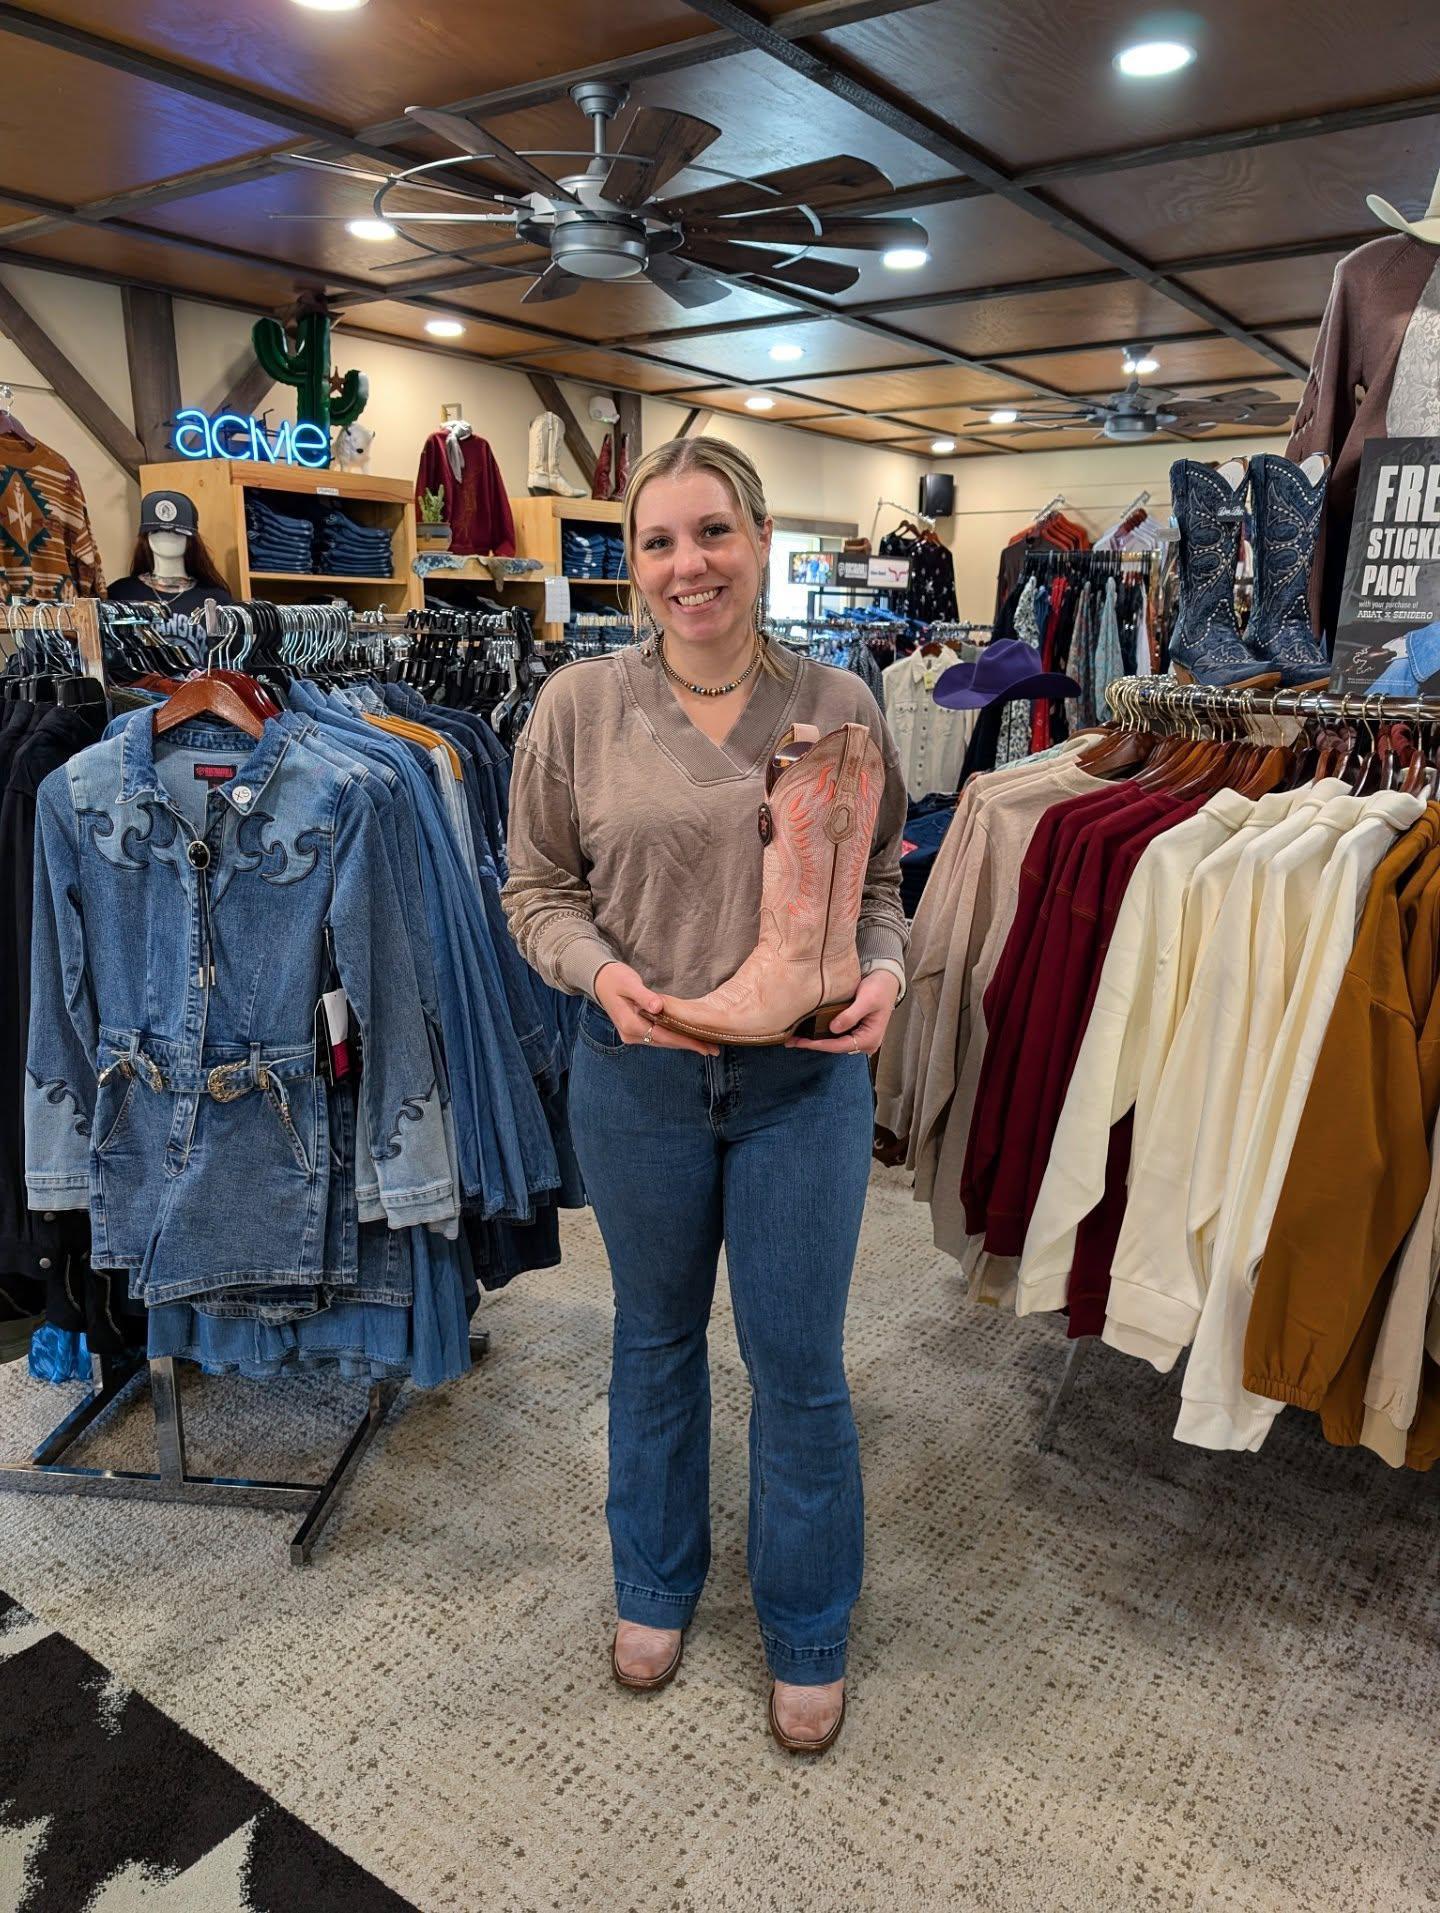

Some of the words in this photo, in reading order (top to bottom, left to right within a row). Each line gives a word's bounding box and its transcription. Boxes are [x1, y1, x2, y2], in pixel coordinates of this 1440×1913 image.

[1361, 565, 1420, 597] PACK
[1357, 610, 1383, 618] ARIAT
[1392, 611, 1434, 620] SENDERO
